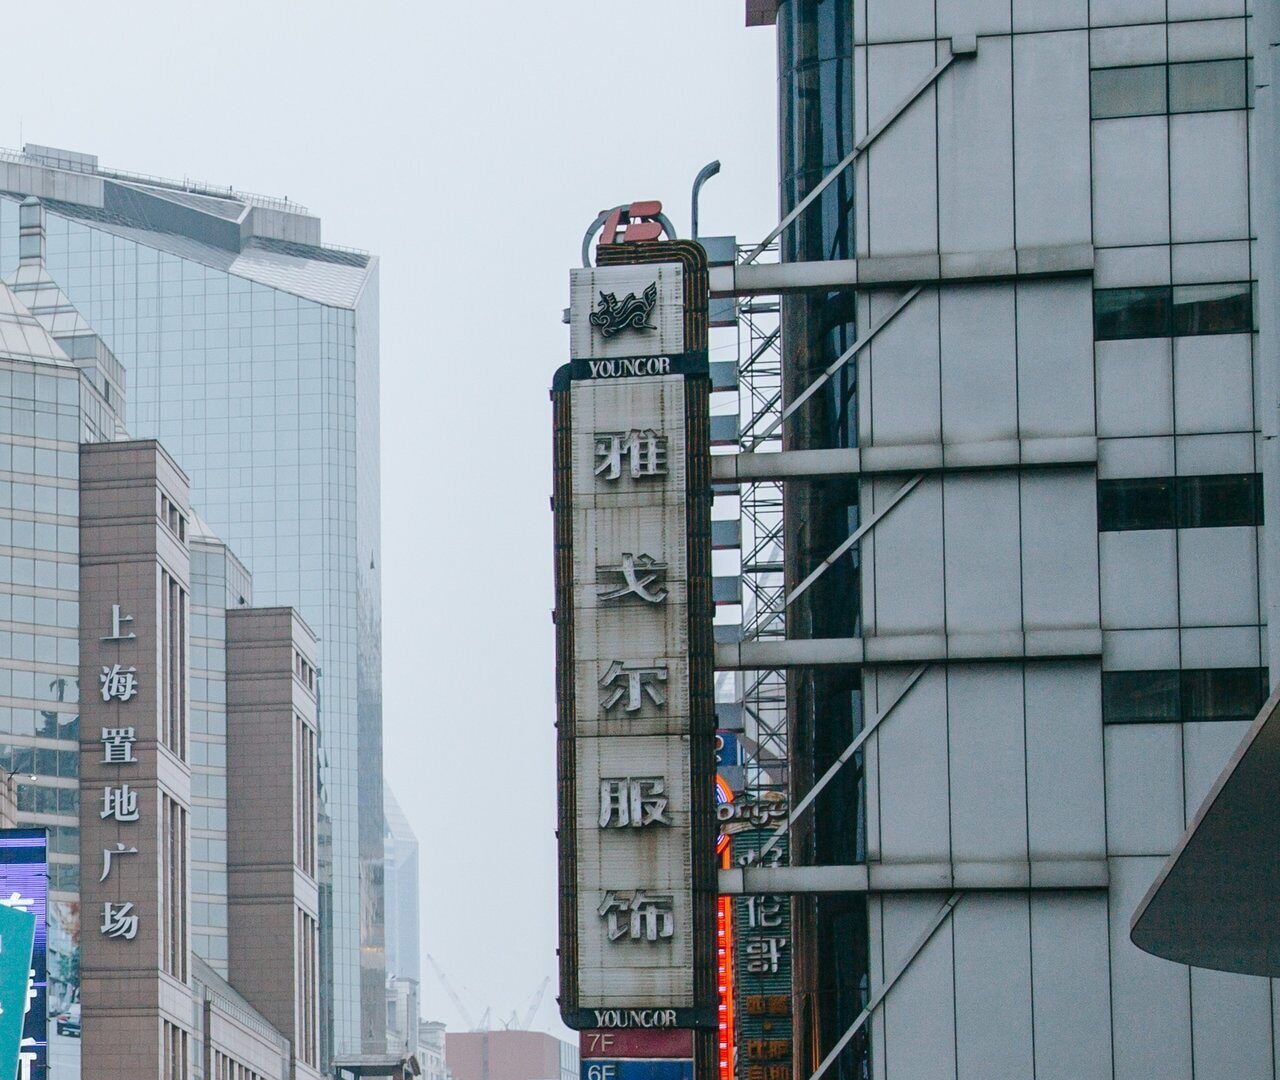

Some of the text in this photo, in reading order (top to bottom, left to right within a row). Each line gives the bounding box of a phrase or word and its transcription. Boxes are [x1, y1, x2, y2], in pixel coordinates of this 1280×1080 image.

[589, 358, 670, 378] YOUNGOR
[593, 429, 677, 944] 雅戈尔服饰
[100, 604, 139, 940] 上海置地广场
[594, 1009, 677, 1029] YOUNGOR
[587, 1033, 615, 1052] 7F
